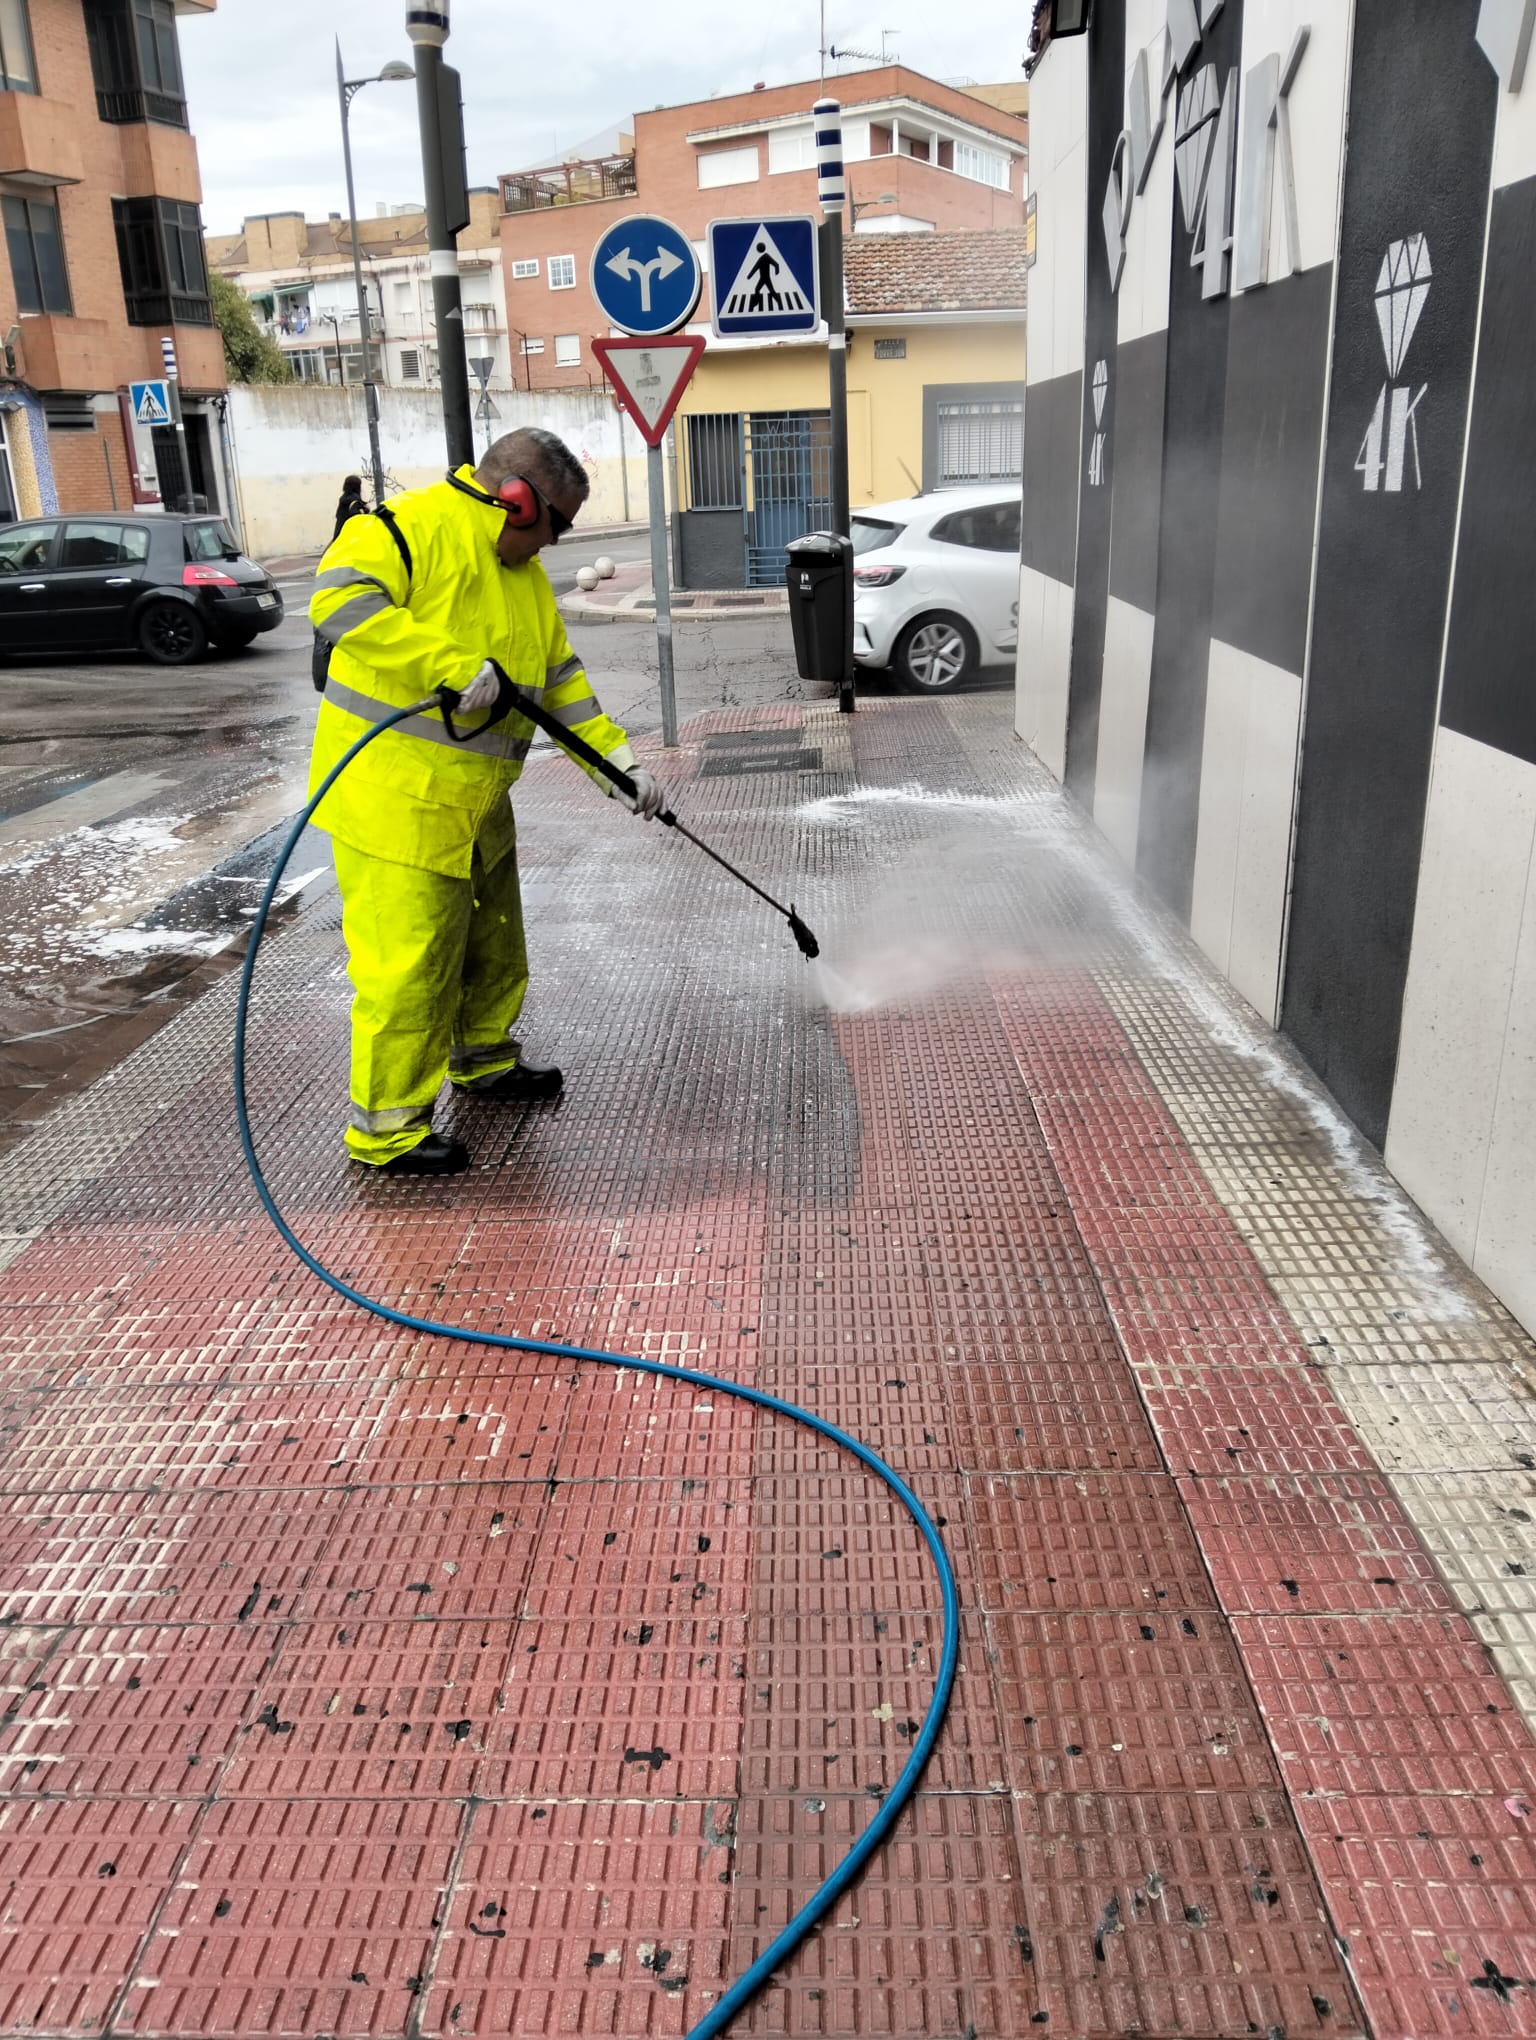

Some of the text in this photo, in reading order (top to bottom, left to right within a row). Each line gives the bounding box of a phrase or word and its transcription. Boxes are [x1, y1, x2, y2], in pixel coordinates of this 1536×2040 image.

[1190, 24, 1312, 300] 4K
[1088, 432, 1106, 486] 4K
[1354, 381, 1428, 492] 4K
